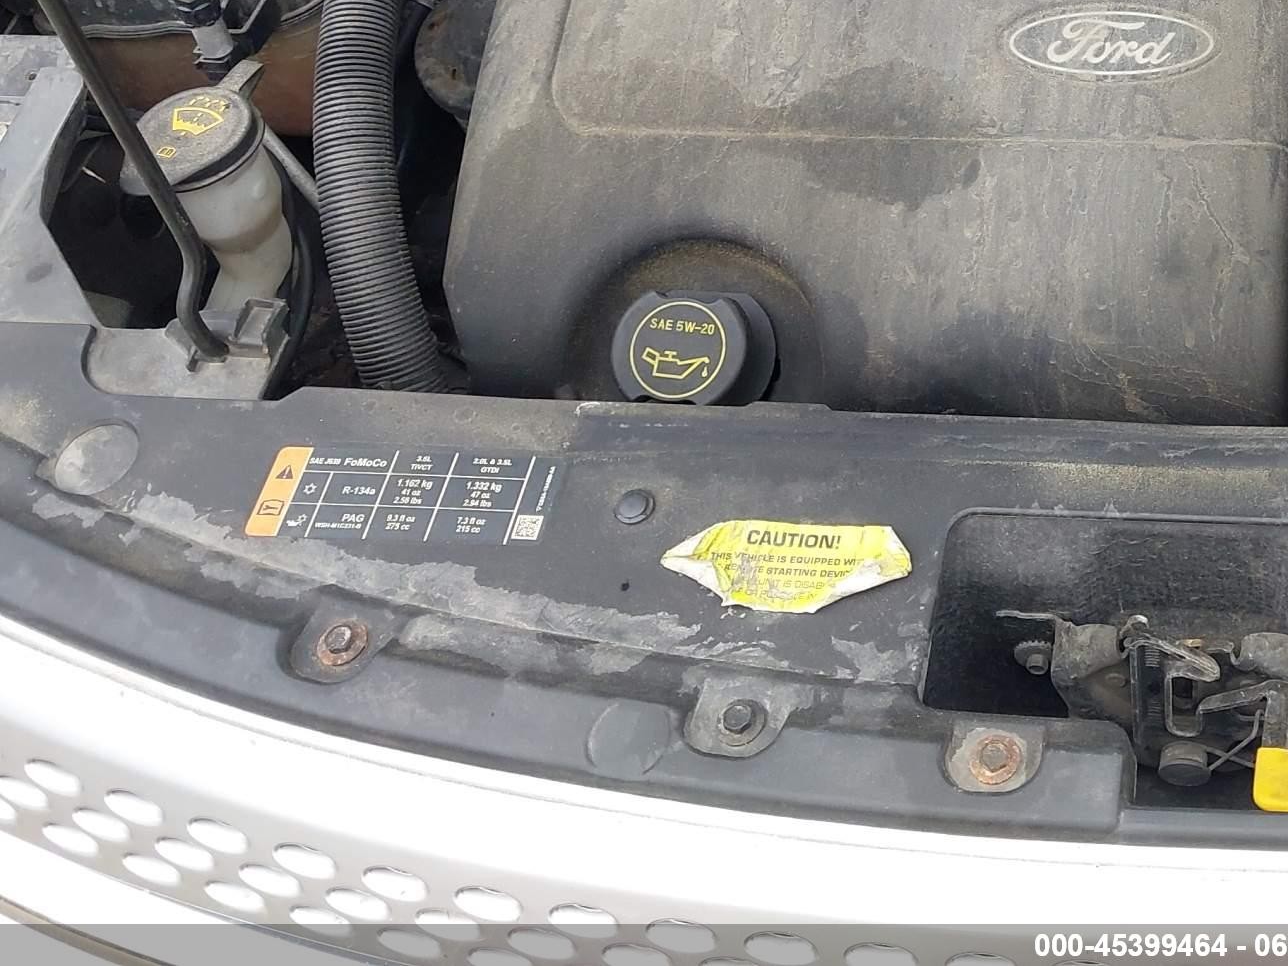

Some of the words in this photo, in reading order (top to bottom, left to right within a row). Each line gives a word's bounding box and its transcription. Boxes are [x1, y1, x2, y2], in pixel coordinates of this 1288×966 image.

[1046, 19, 1177, 64] Ford
[649, 318, 674, 331] SAE
[675, 320, 715, 335] 5W-20
[343, 457, 388, 467] FoMoCo
[397, 478, 421, 488] 1.162
[421, 479, 434, 490] kg
[466, 481, 490, 491] 1.332
[490, 482, 503, 493] kg
[341, 486, 376, 495] R-134a
[401, 488, 411, 496] 41
[470, 491, 481, 499] 47
[410, 497, 423, 505] lbs
[480, 499, 492, 508] lbs
[341, 513, 366, 523] PAG
[455, 525, 471, 533] 215
[747, 530, 841, 549] CAUTION!
[711, 552, 732, 560] THIS
[735, 553, 775, 563] VEHICLE
[777, 555, 787, 563] IS
[790, 556, 841, 566] EQUIPPED
[766, 565, 817, 577] STARTING
